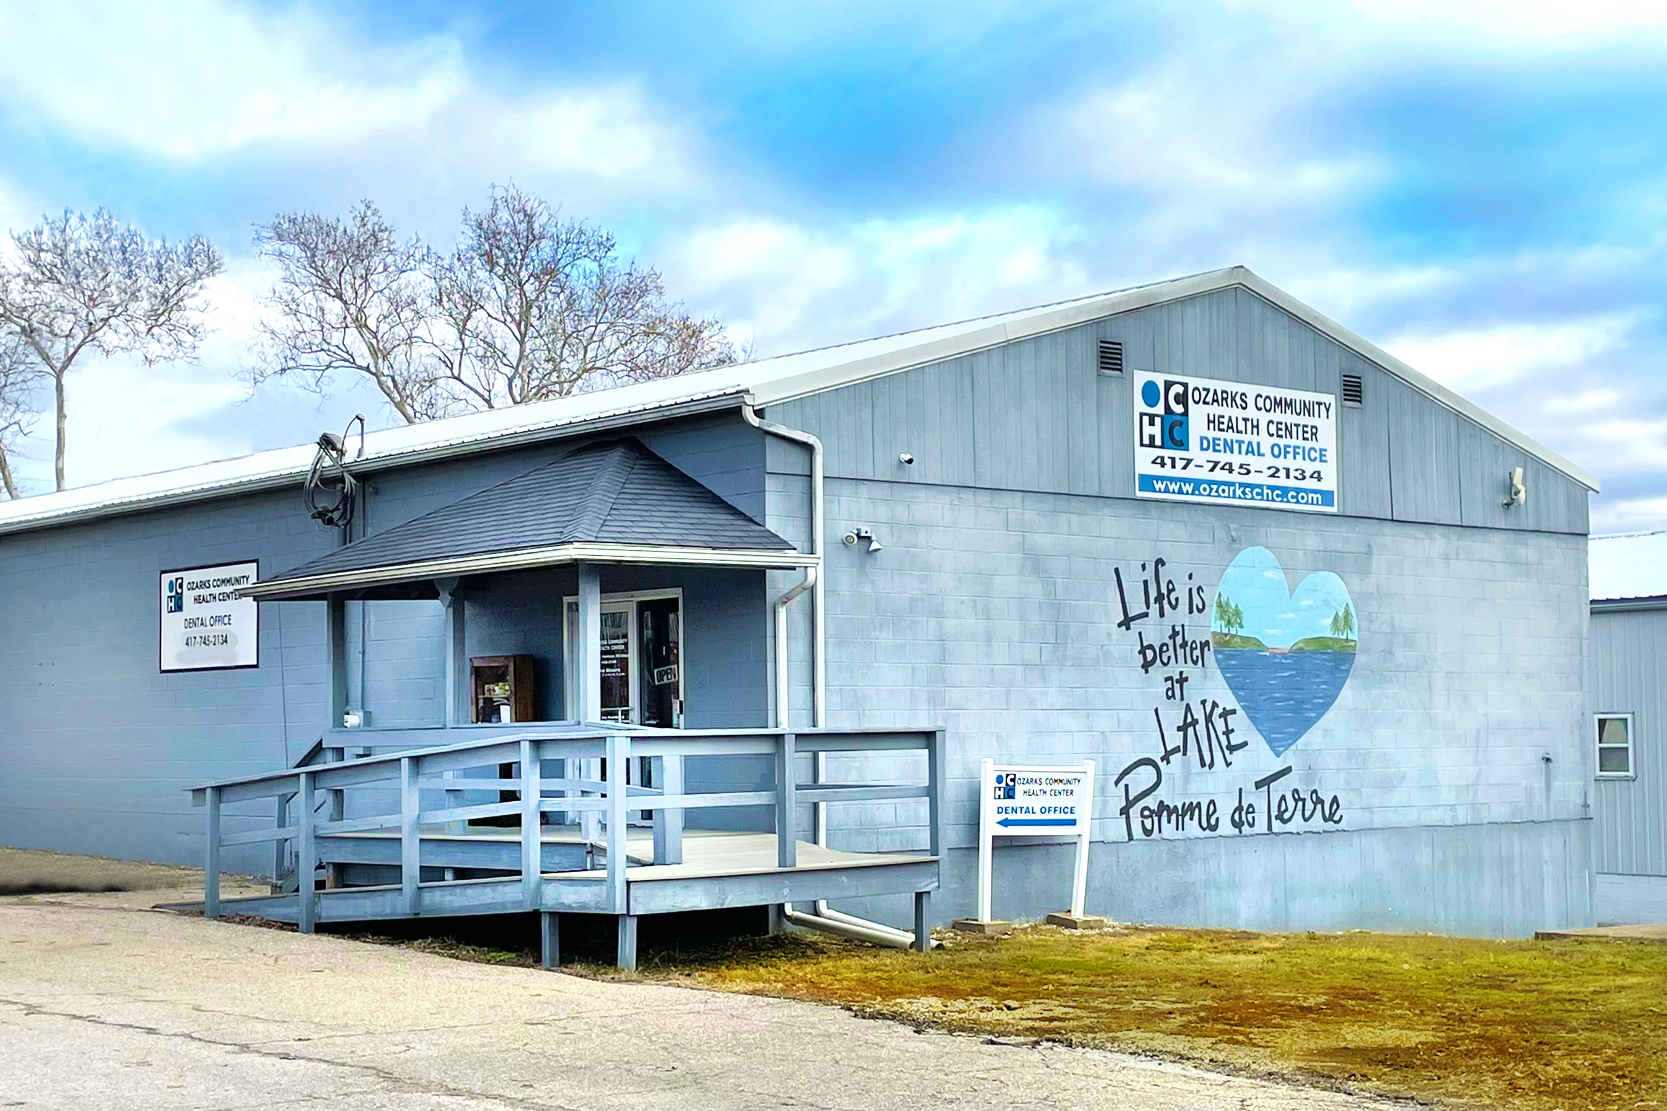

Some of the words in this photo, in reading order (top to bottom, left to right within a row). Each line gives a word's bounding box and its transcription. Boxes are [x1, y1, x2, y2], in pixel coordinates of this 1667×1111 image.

[1191, 386, 1248, 411] OZARKS
[1255, 393, 1331, 419] COMMUNITY
[1207, 413, 1260, 436] HEALTH
[1267, 420, 1319, 442] CENTER
[1199, 435, 1265, 457] DENTAL
[1271, 443, 1328, 463] OFFICE
[1151, 455, 1323, 482] 417-745-2134
[1153, 479, 1322, 505] www.ozarkschc.com
[187, 579, 211, 591] OZARKS
[212, 575, 250, 589] COMMUNITY
[1114, 557, 1179, 631] Life
[1188, 572, 1206, 614] is
[193, 593, 217, 605] HEALTH
[184, 617, 207, 629] DENTAL
[209, 614, 232, 627] OFFICE
[185, 634, 228, 647] 417-745-2134
[1138, 624, 1210, 674] better
[1164, 671, 1189, 701] at
[1154, 699, 1248, 770] LAKE
[1017, 778, 1043, 786] OZARKS
[1045, 777, 1081, 786] COMMUNITY
[997, 806, 1036, 814] DENTAL
[1040, 806, 1076, 814] OFFICE
[1114, 757, 1219, 841] Pomme
[1230, 787, 1256, 834] de
[1255, 766, 1343, 832] Terre
